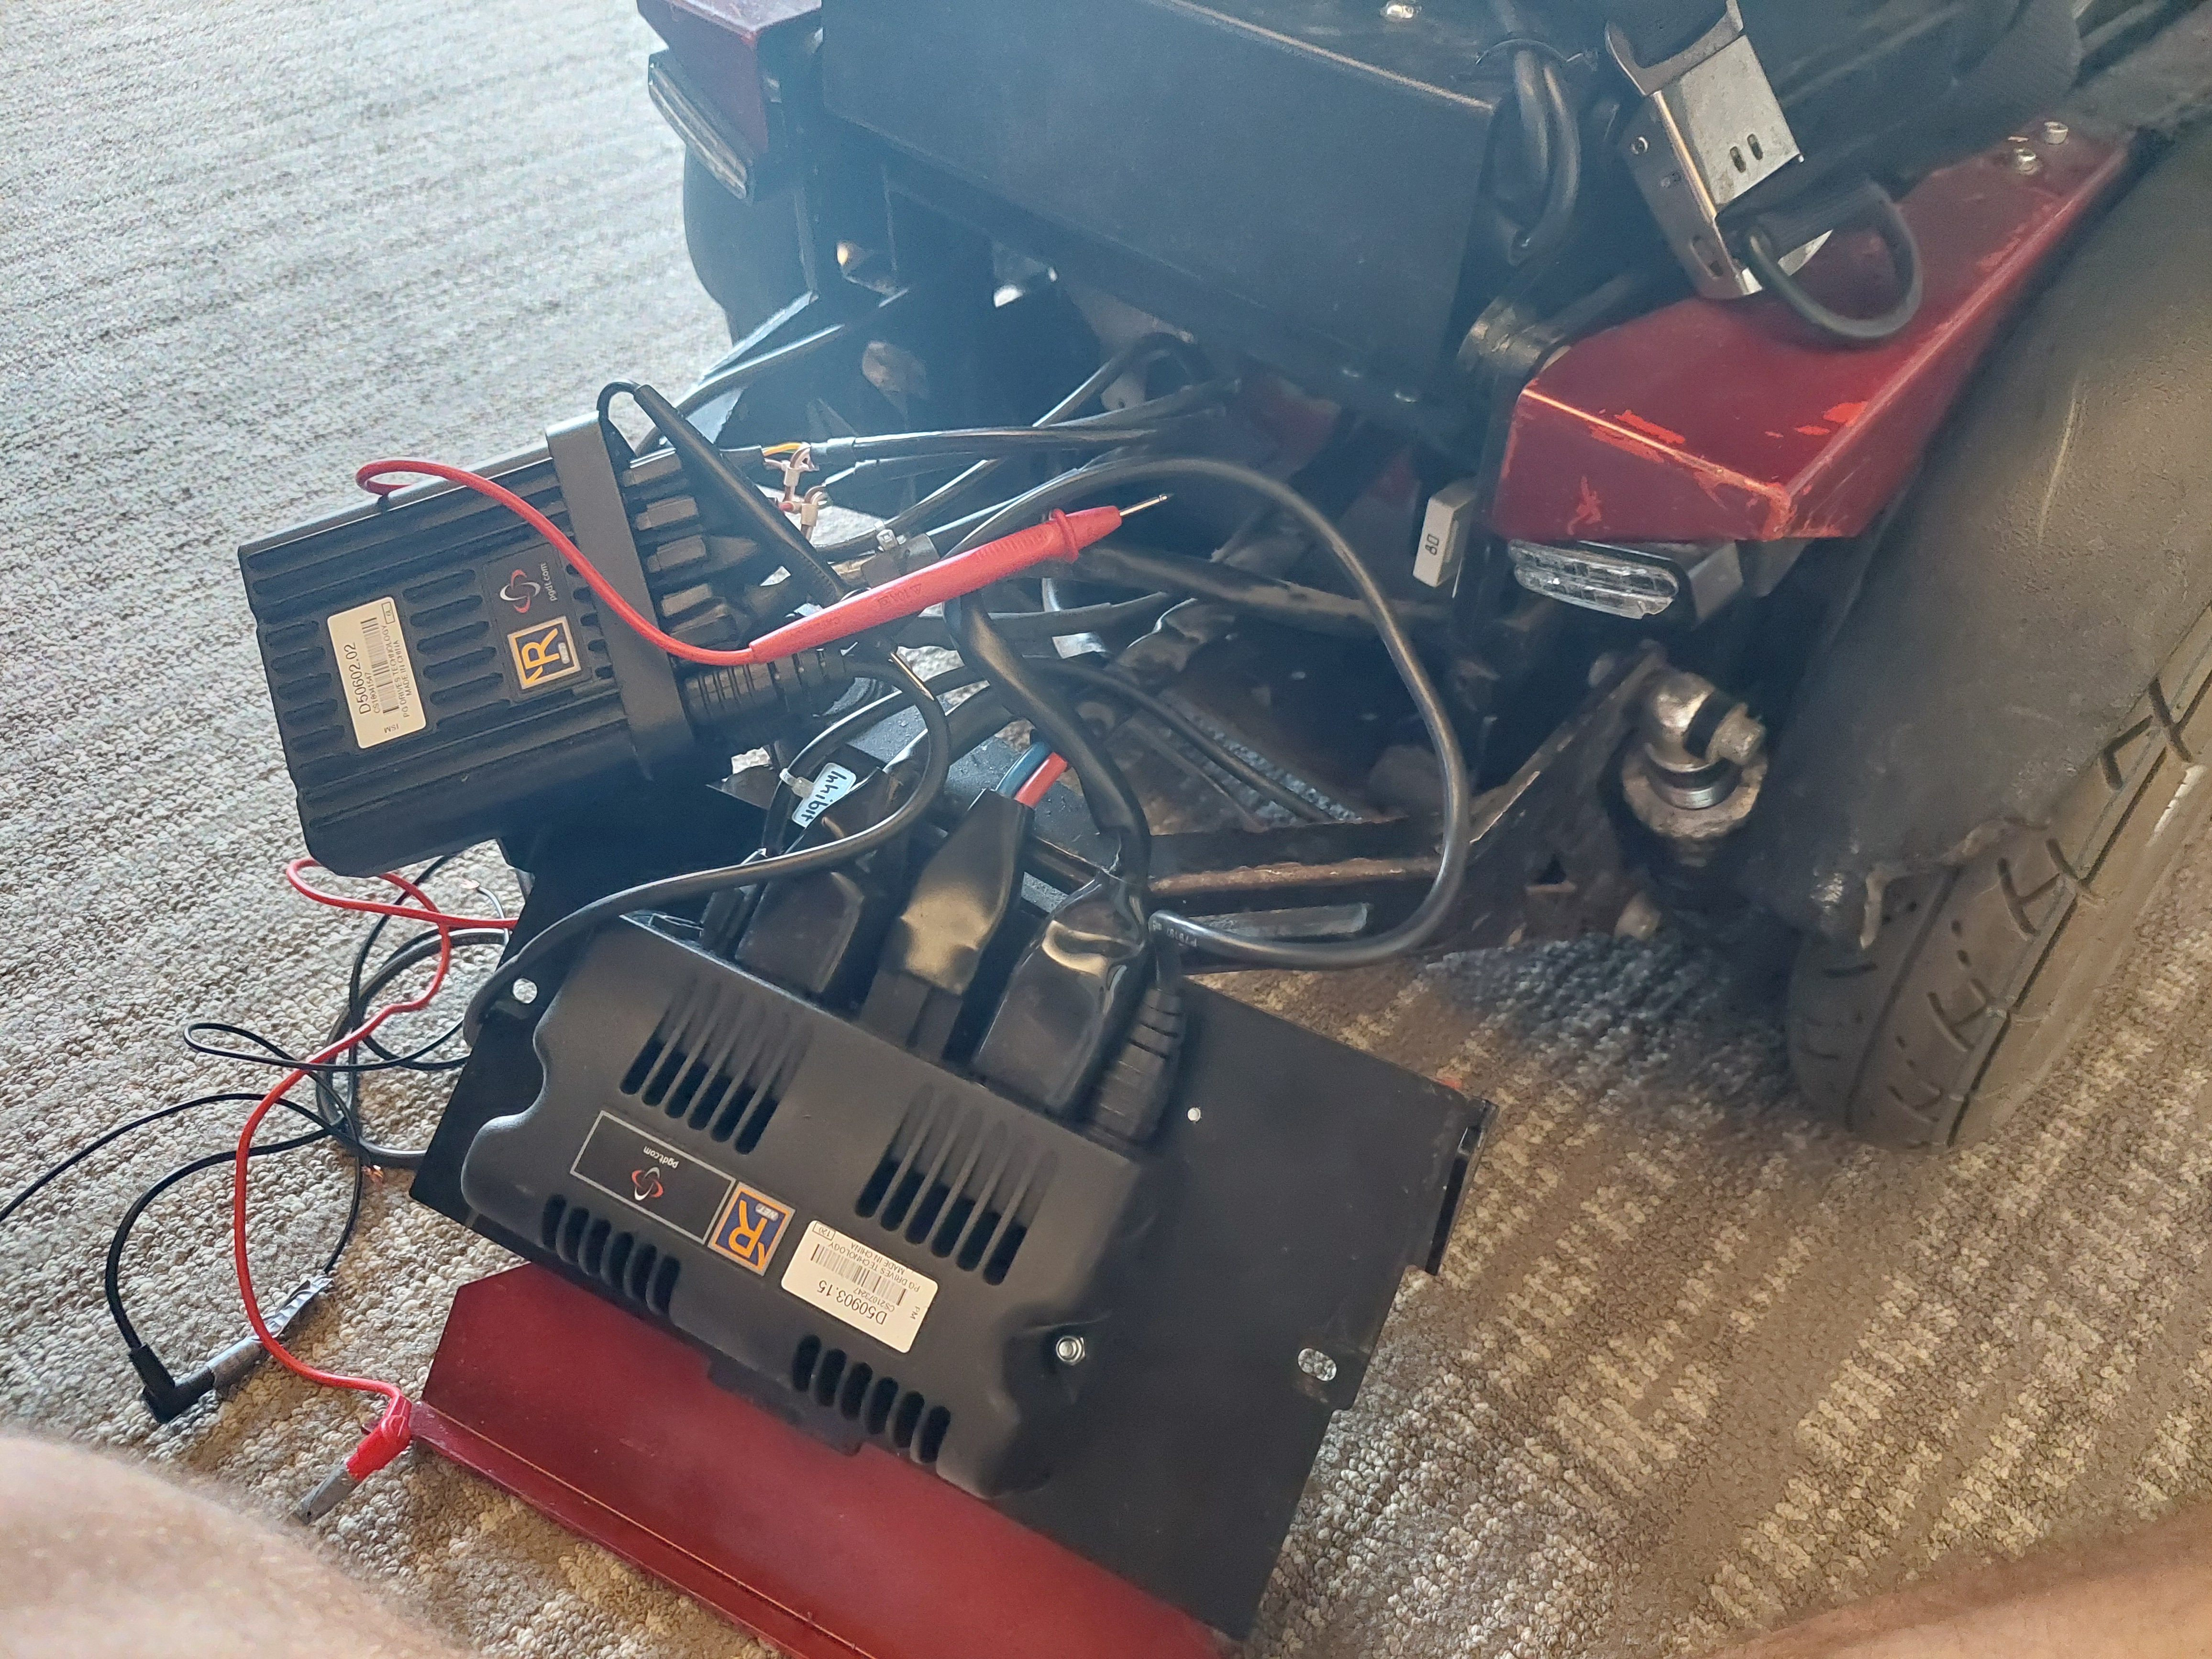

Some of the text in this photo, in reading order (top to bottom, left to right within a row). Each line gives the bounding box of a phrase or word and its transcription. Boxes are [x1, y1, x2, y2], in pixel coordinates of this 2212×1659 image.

[541, 562, 558, 601] pgdt.com
[381, 622, 398, 676] TECHNOLOGY
[343, 643, 371, 714] D50602.02
[393, 640, 412, 696] MADE IN CHINA
[394, 676, 407, 705] DRIVES
[383, 723, 399, 733] ISM
[801, 770, 847, 822] Inhibit
[643, 1146, 679, 1168] pgdt.com
[756, 1203, 778, 1219] NET
[818, 1227, 830, 1237] 120
[828, 1239, 878, 1272] TECHNOLOGY
[851, 1242, 905, 1275] MADE IN CHINA
[880, 1267, 907, 1286] DRIVES
[817, 1280, 887, 1325] D50903.15
[909, 1305, 920, 1320] PM
